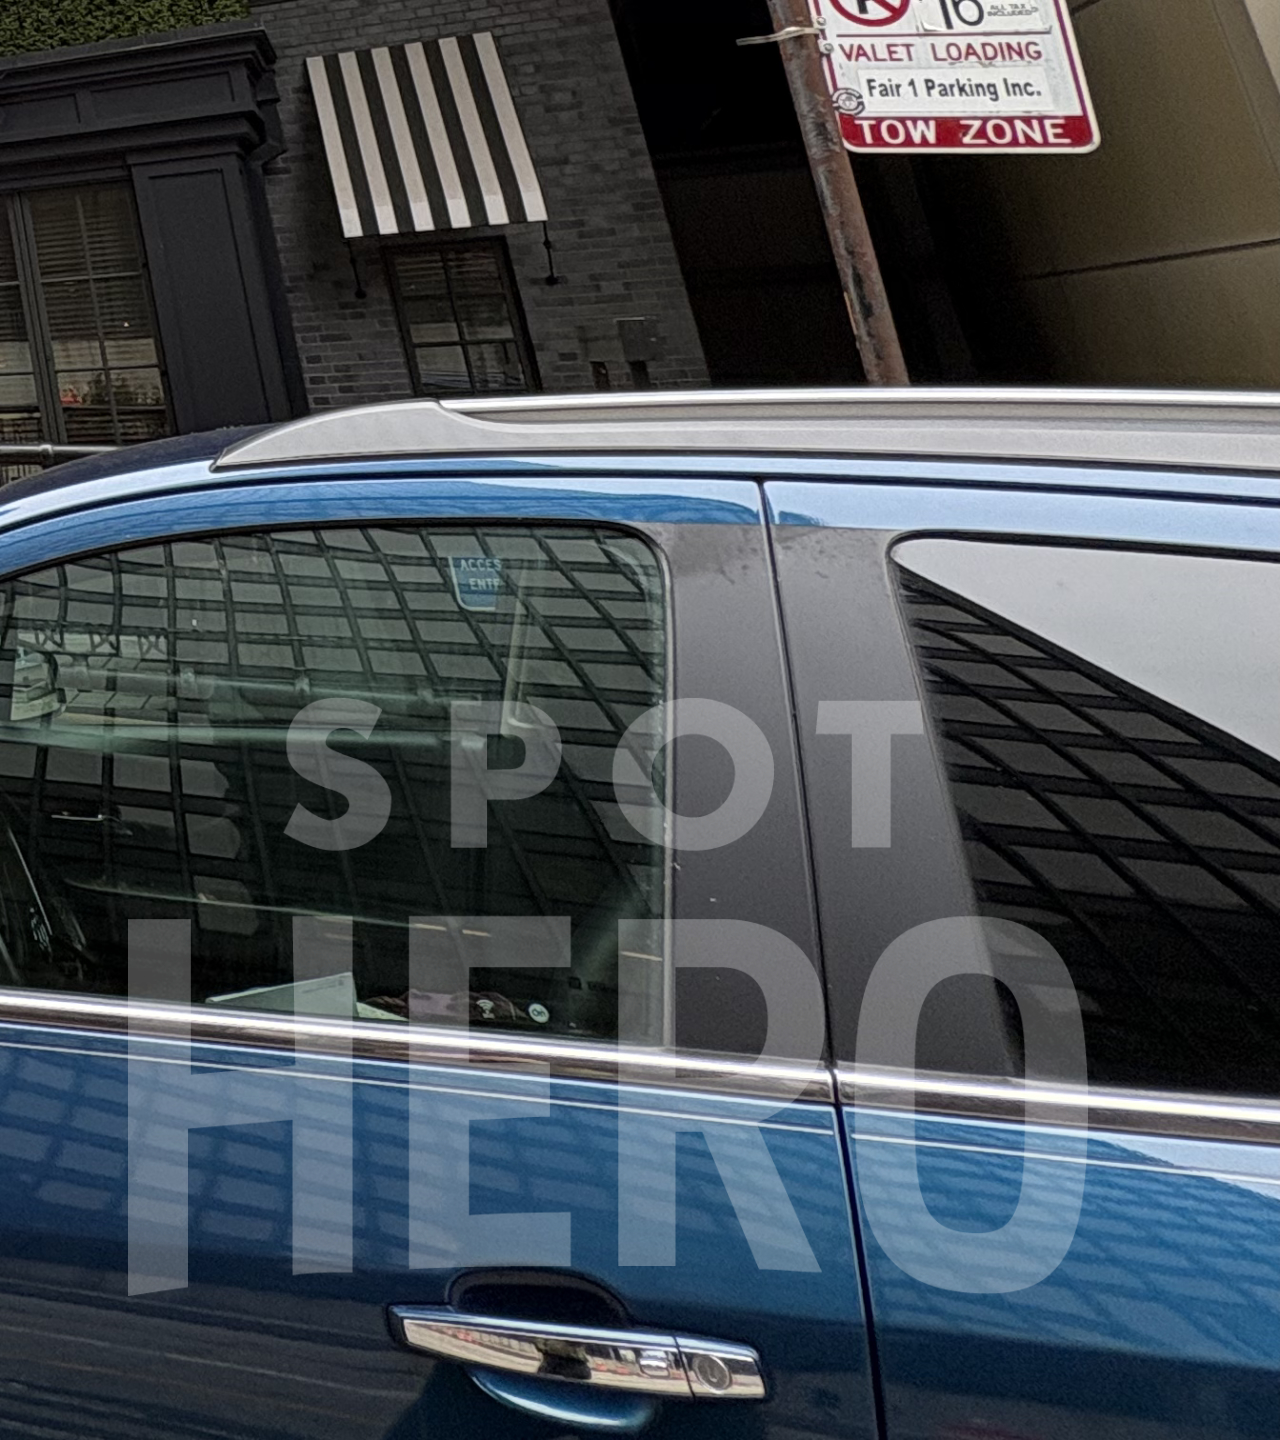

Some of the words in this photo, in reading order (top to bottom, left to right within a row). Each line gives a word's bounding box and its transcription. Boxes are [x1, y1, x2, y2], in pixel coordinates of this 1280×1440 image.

[838, 42, 915, 62] VALET
[931, 41, 1043, 61] LOADING
[866, 78, 902, 98] Fair
[907, 78, 918, 97] 1
[925, 78, 1000, 102] Parking
[1004, 77, 1042, 97] Inc.
[854, 119, 937, 145] TOW
[959, 118, 1072, 145] ZONE
